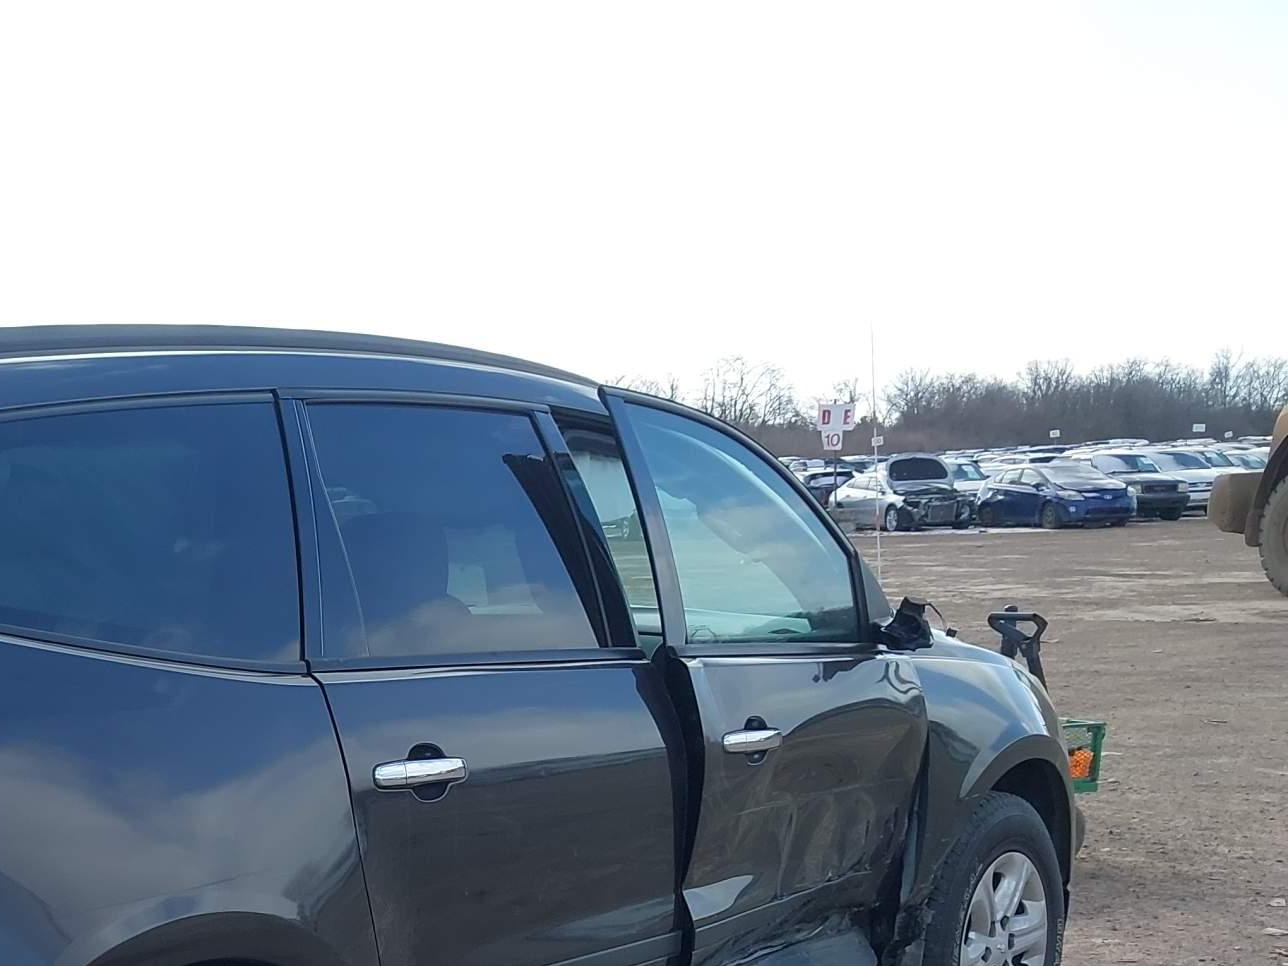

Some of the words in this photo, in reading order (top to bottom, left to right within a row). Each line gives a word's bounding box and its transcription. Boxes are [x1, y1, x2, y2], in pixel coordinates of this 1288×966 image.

[821, 408, 832, 426] D
[842, 408, 852, 426] E
[824, 433, 841, 447] 10
